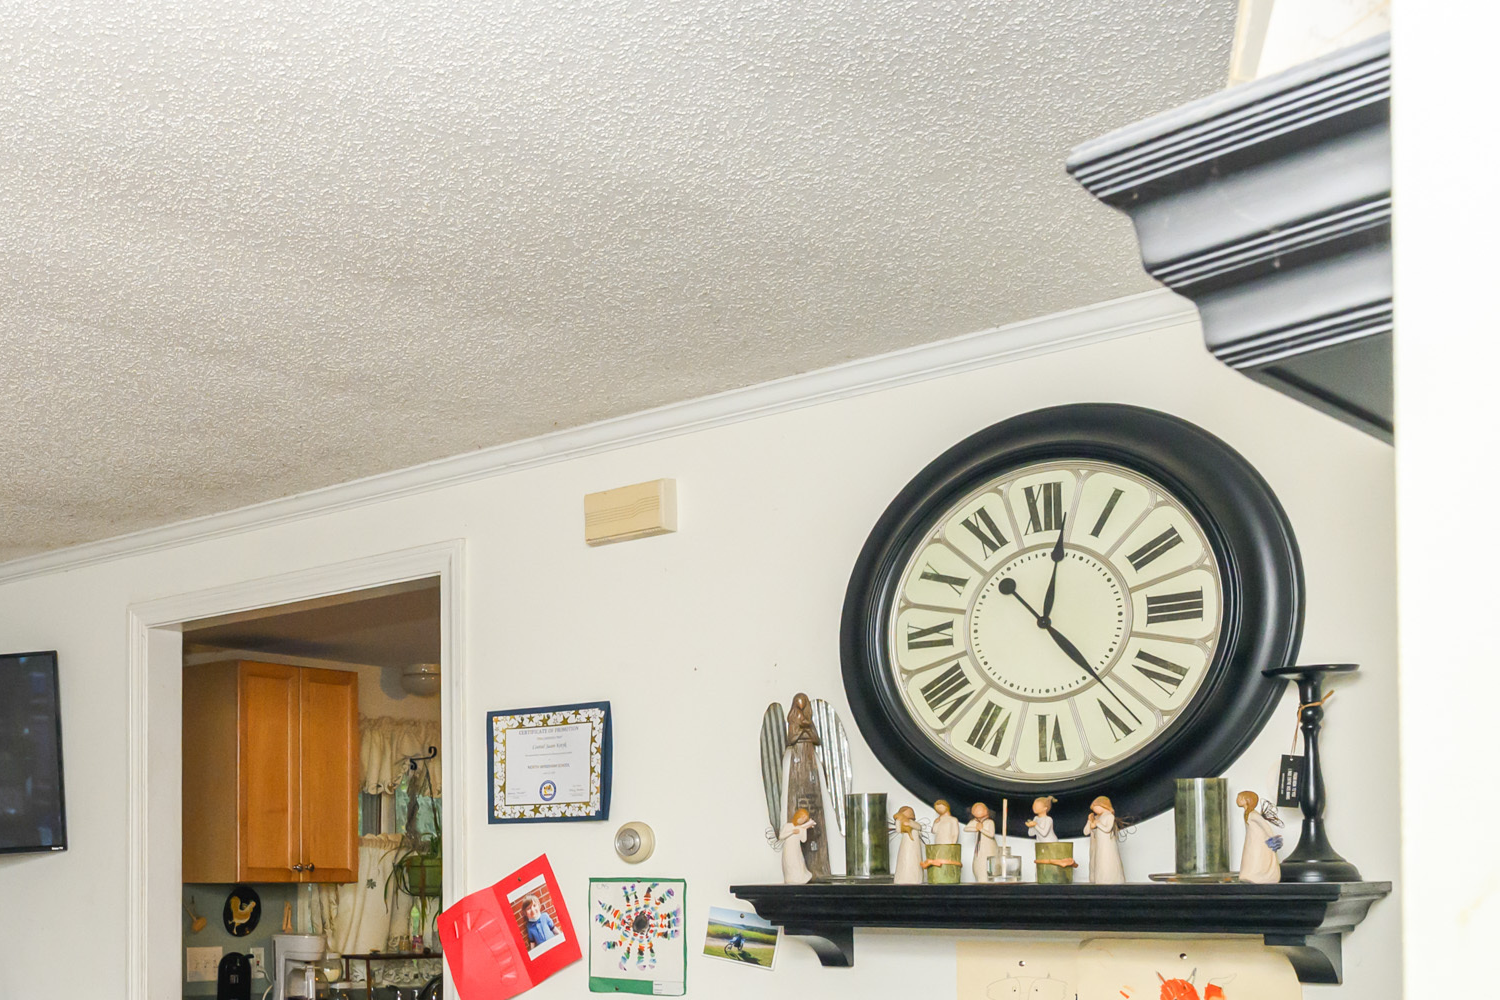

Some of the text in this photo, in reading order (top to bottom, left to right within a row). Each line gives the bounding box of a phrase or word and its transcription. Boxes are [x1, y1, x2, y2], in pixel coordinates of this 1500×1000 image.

[959, 505, 1011, 561] XI
[1021, 481, 1065, 536] XII
[1089, 487, 1125, 538] I
[1125, 524, 1184, 573] II
[918, 561, 971, 597] X
[1145, 586, 1203, 627] III
[907, 618, 954, 652] IX
[920, 660, 976, 725] VIII
[964, 699, 1012, 758] VII
[1097, 698, 1136, 743] V
